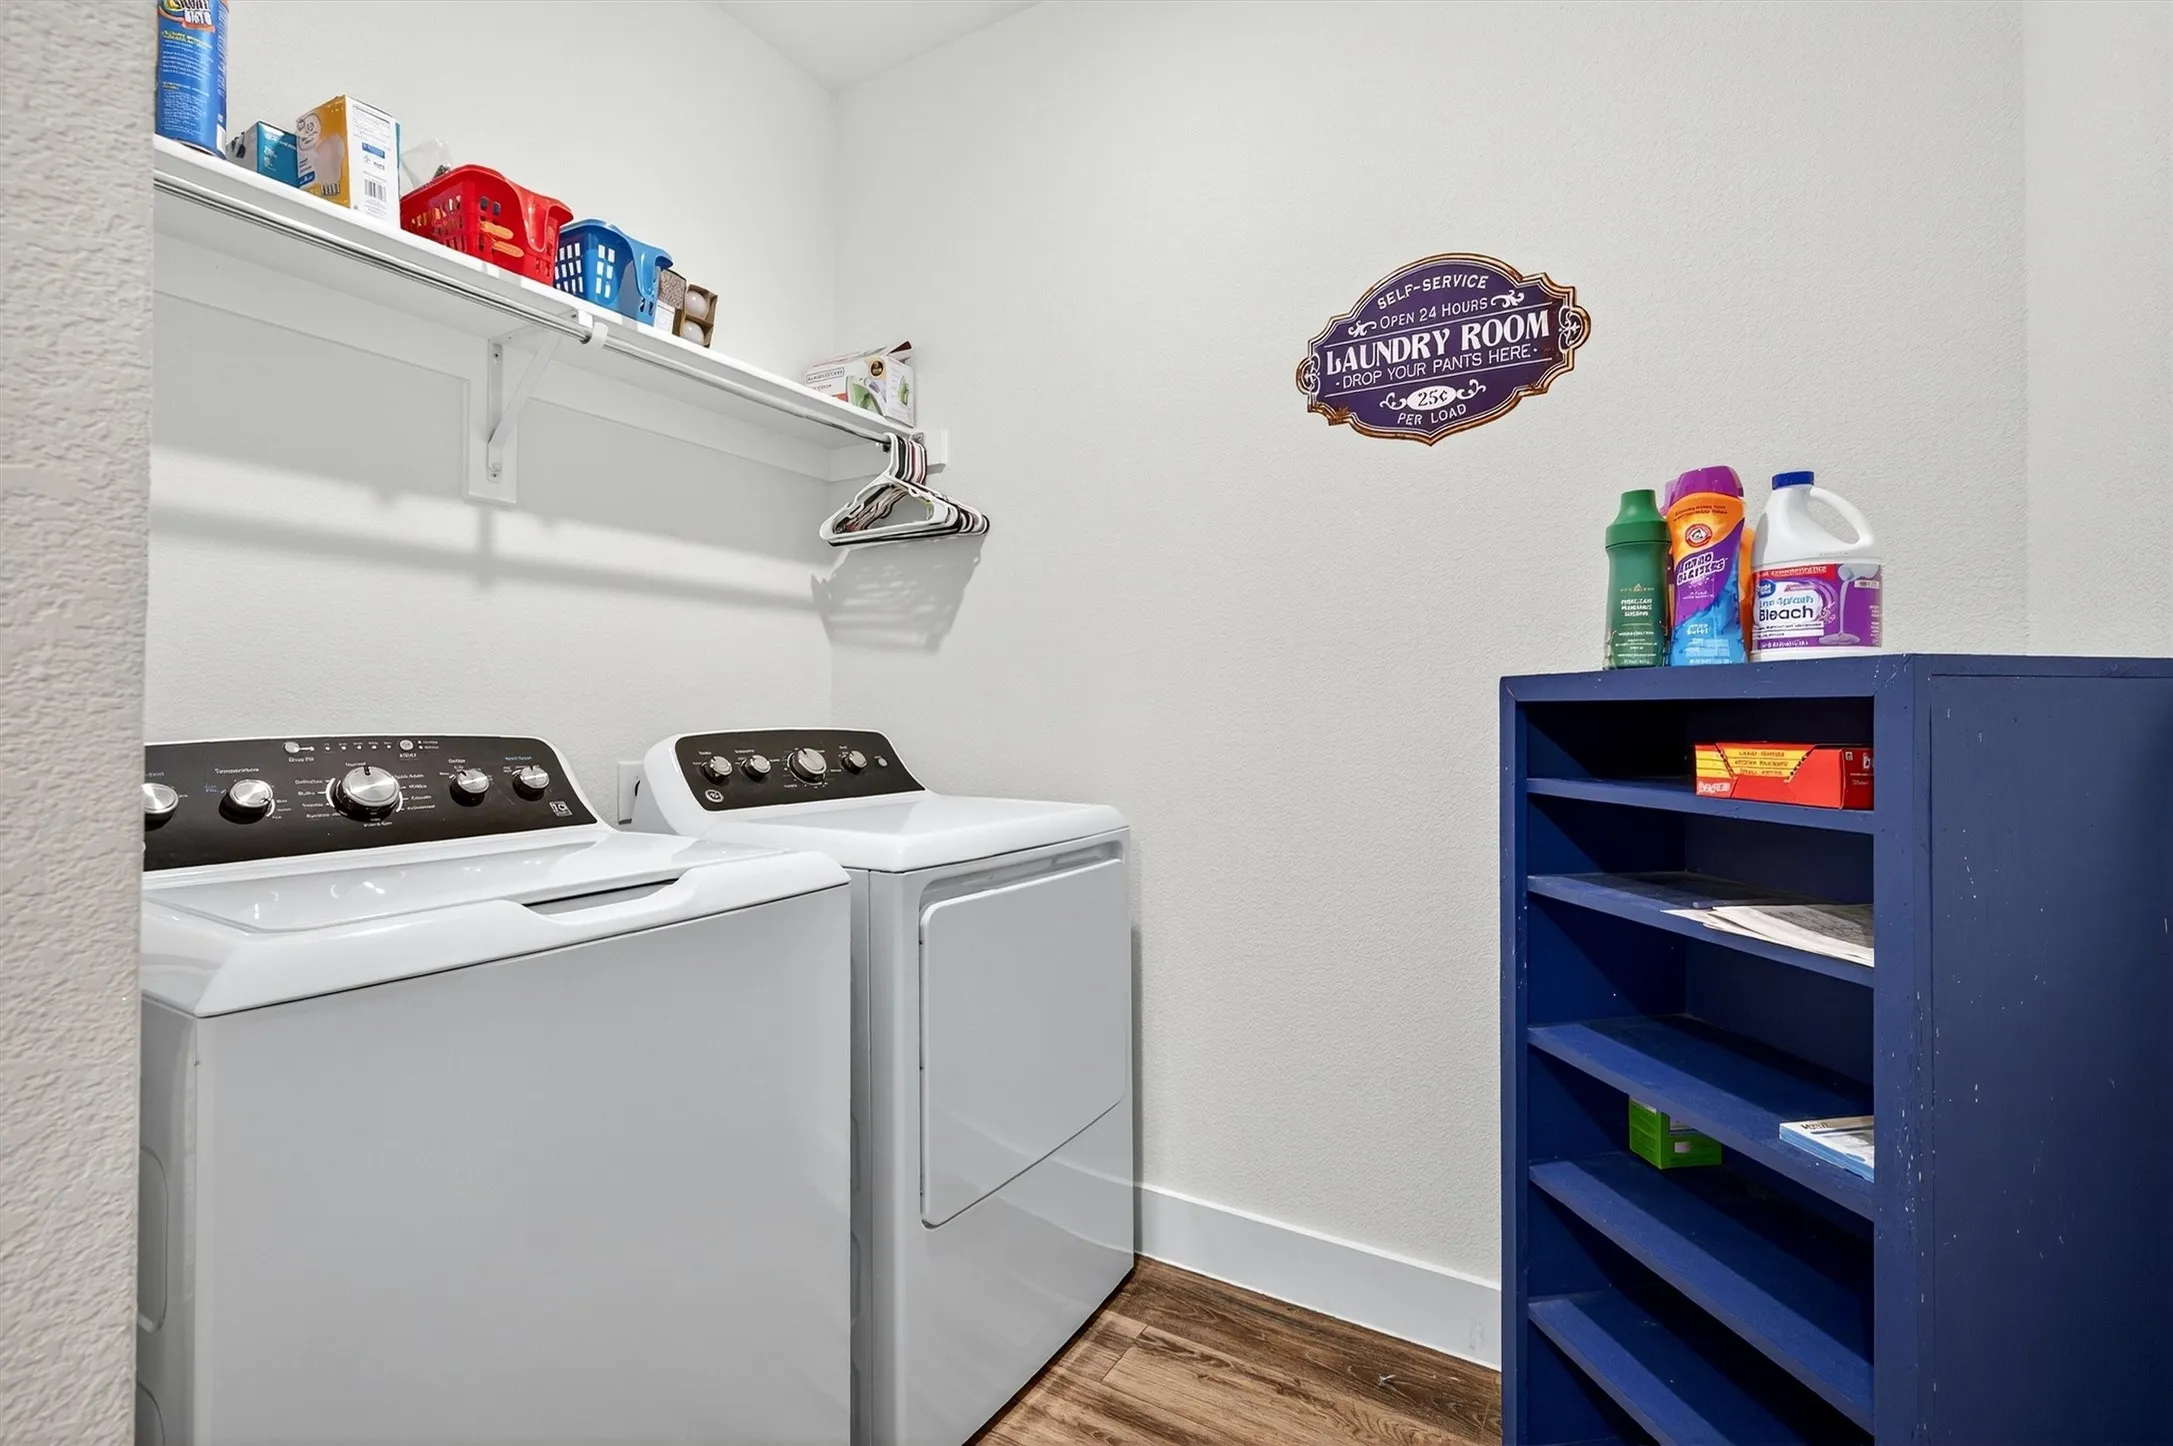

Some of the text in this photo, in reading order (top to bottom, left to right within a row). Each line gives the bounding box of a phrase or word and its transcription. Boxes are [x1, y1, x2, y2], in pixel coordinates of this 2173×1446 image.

[1377, 274, 1489, 310] SELF-SERVICE
[1379, 298, 1488, 330] OPEN 24 HOURS
[1326, 309, 1550, 376] LAUNDRY ROOM
[1343, 343, 1532, 389] DROP YOUR PANTS HERE
[1397, 403, 1467, 425] PER LOAD
[1417, 389, 1449, 407] 25¢
[1759, 605, 1814, 622] Bleach
